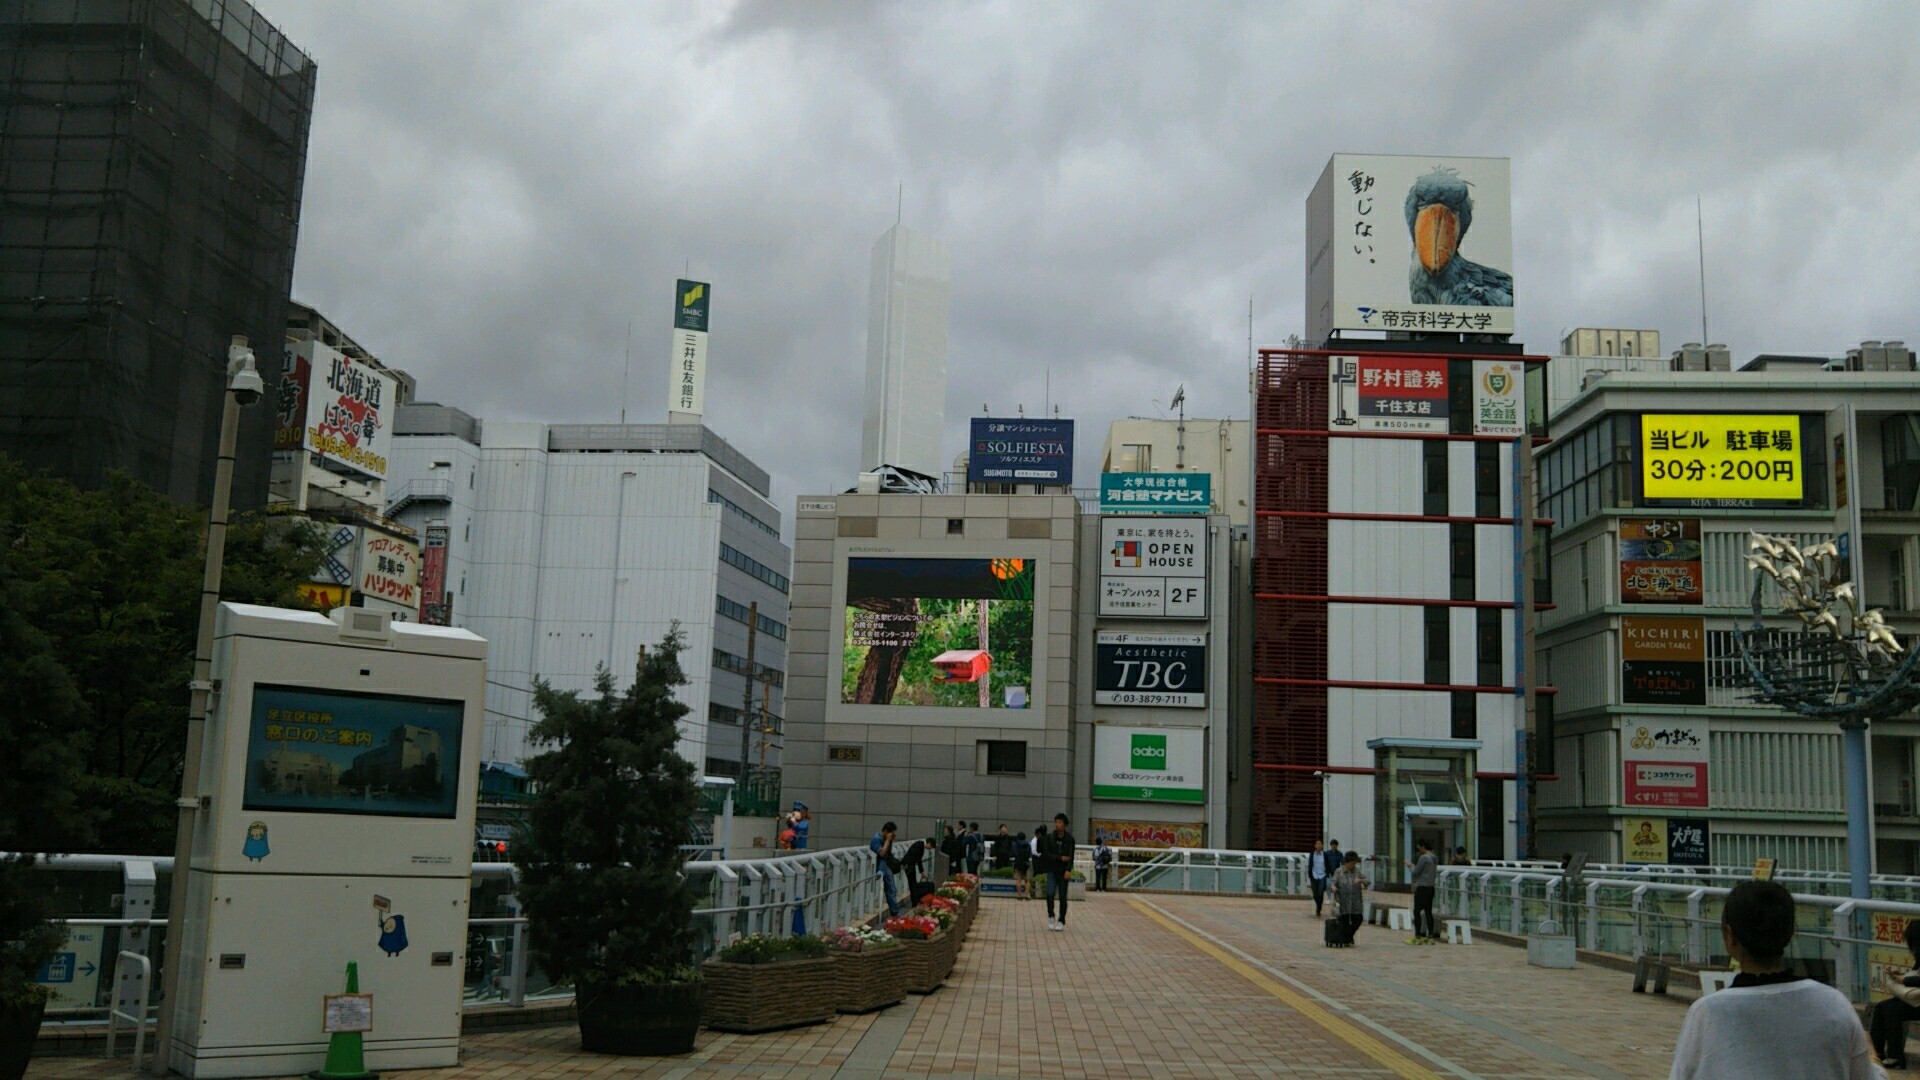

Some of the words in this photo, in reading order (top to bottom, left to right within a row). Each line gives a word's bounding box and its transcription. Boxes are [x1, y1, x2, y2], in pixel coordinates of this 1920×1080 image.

[1348, 170, 1375, 264] 動じない。
[682, 308, 703, 317] SMBC
[1381, 310, 1492, 330] 帝京科学大学
[681, 334, 697, 409] 三井住友銀行
[327, 358, 382, 410] 北海道
[1363, 368, 1444, 389] 野村證券
[1375, 400, 1432, 414] 千住支店
[1480, 398, 1516, 408] シェーン
[1480, 408, 1516, 420] 英会話
[324, 402, 377, 446] はなの舞
[1650, 429, 1710, 450] 当ビル
[1726, 430, 1793, 451] 駐車場
[987, 441, 1065, 455] SOLFIESTA
[1000, 456, 1042, 464] ソルフィエスタ
[1123, 477, 1187, 487] 大学現役合格
[1107, 489, 1203, 502] 河合塾マナビス
[1691, 499, 1711, 507] KITA
[1716, 499, 1755, 507] TERRACE
[1117, 528, 1194, 538] 東京に、家を持とう。
[367, 538, 416, 564] フロアレディー
[1148, 543, 1194, 554] OPEN
[377, 555, 405, 577] 募集中
[1148, 557, 1194, 567] HOUSE
[364, 573, 414, 601] ハリウッド
[1627, 576, 1696, 592] 北海道
[1106, 587, 1160, 598] オープンハウス
[1171, 588, 1198, 603] 2F
[1116, 634, 1129, 643] 4F
[1627, 628, 1698, 639] KICHIRI
[1634, 641, 1666, 649] GARDEN
[1668, 642, 1693, 650] TABLE
[1115, 647, 1188, 658] Aesthetic
[1113, 660, 1187, 690] TBC
[1123, 694, 1188, 704] 03-3879-7111
[267, 709, 334, 724] 足立区役所
[265, 724, 373, 747] 窓口のご案内
[1653, 728, 1701, 746] かまどか
[1653, 771, 1694, 779] ココカラファイン
[1141, 788, 1155, 798] 3F
[1634, 792, 1659, 802] くすり
[1671, 825, 1704, 848] 大戸屋
